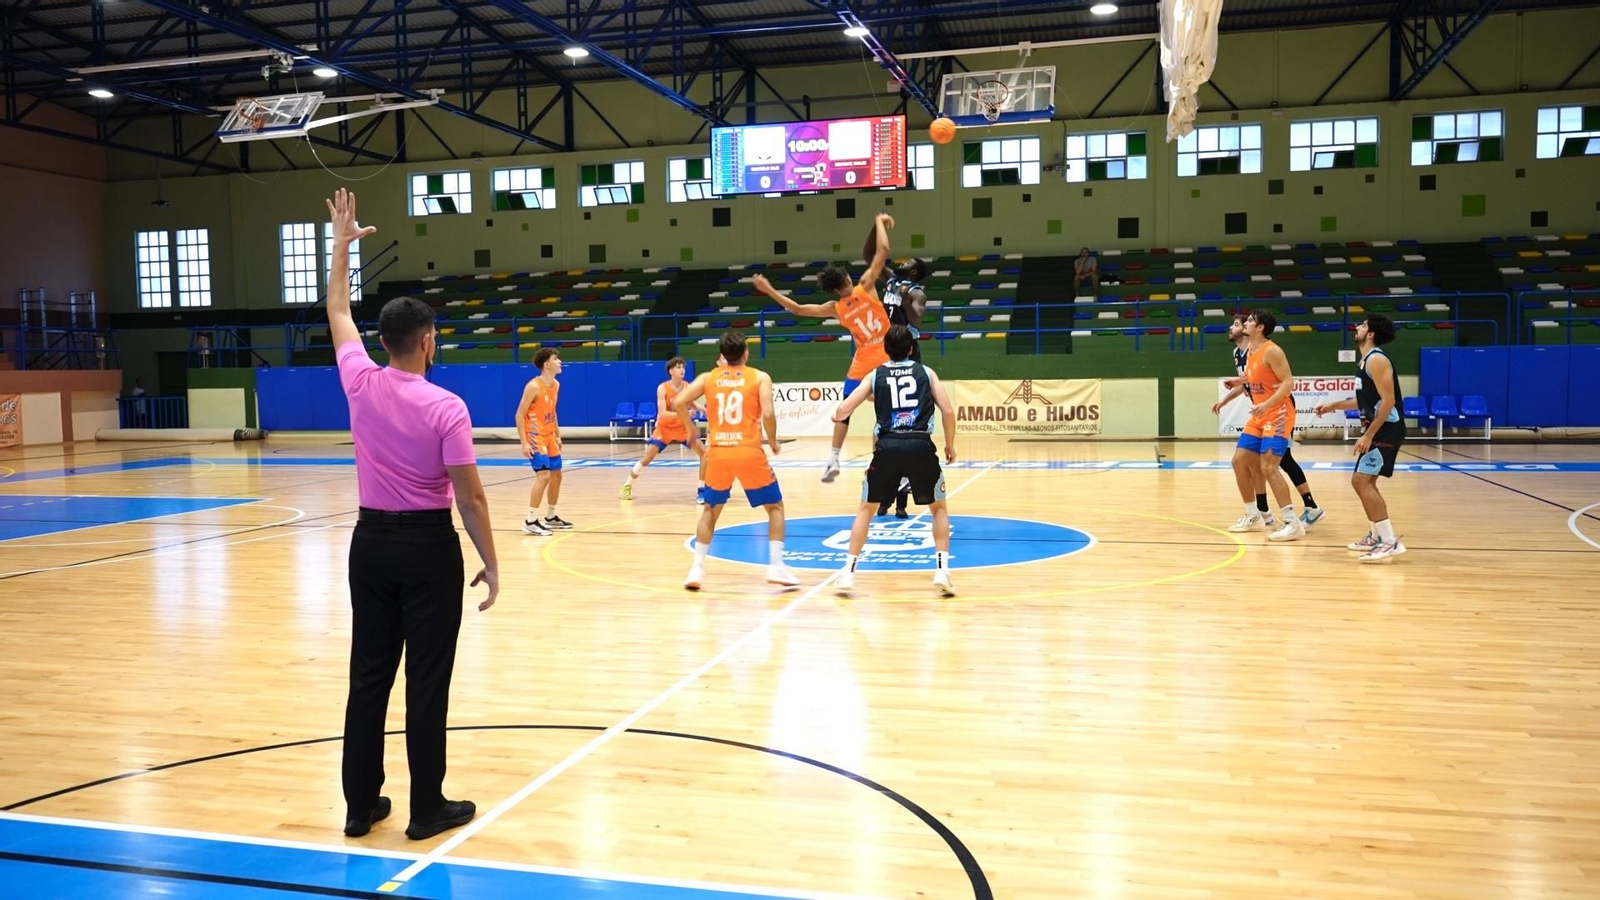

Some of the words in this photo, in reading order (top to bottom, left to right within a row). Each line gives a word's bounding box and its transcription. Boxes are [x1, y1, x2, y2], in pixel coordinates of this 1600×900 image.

[788, 139, 828, 152] 10:00
[760, 175, 771, 189] 0
[845, 171, 856, 184] 0
[853, 309, 882, 340] 14
[886, 375, 919, 409] 12
[1293, 379, 1311, 392] uiz
[957, 406, 1018, 422] AMADO
[1027, 408, 1037, 421] e
[1046, 405, 1100, 421] HIJOS
